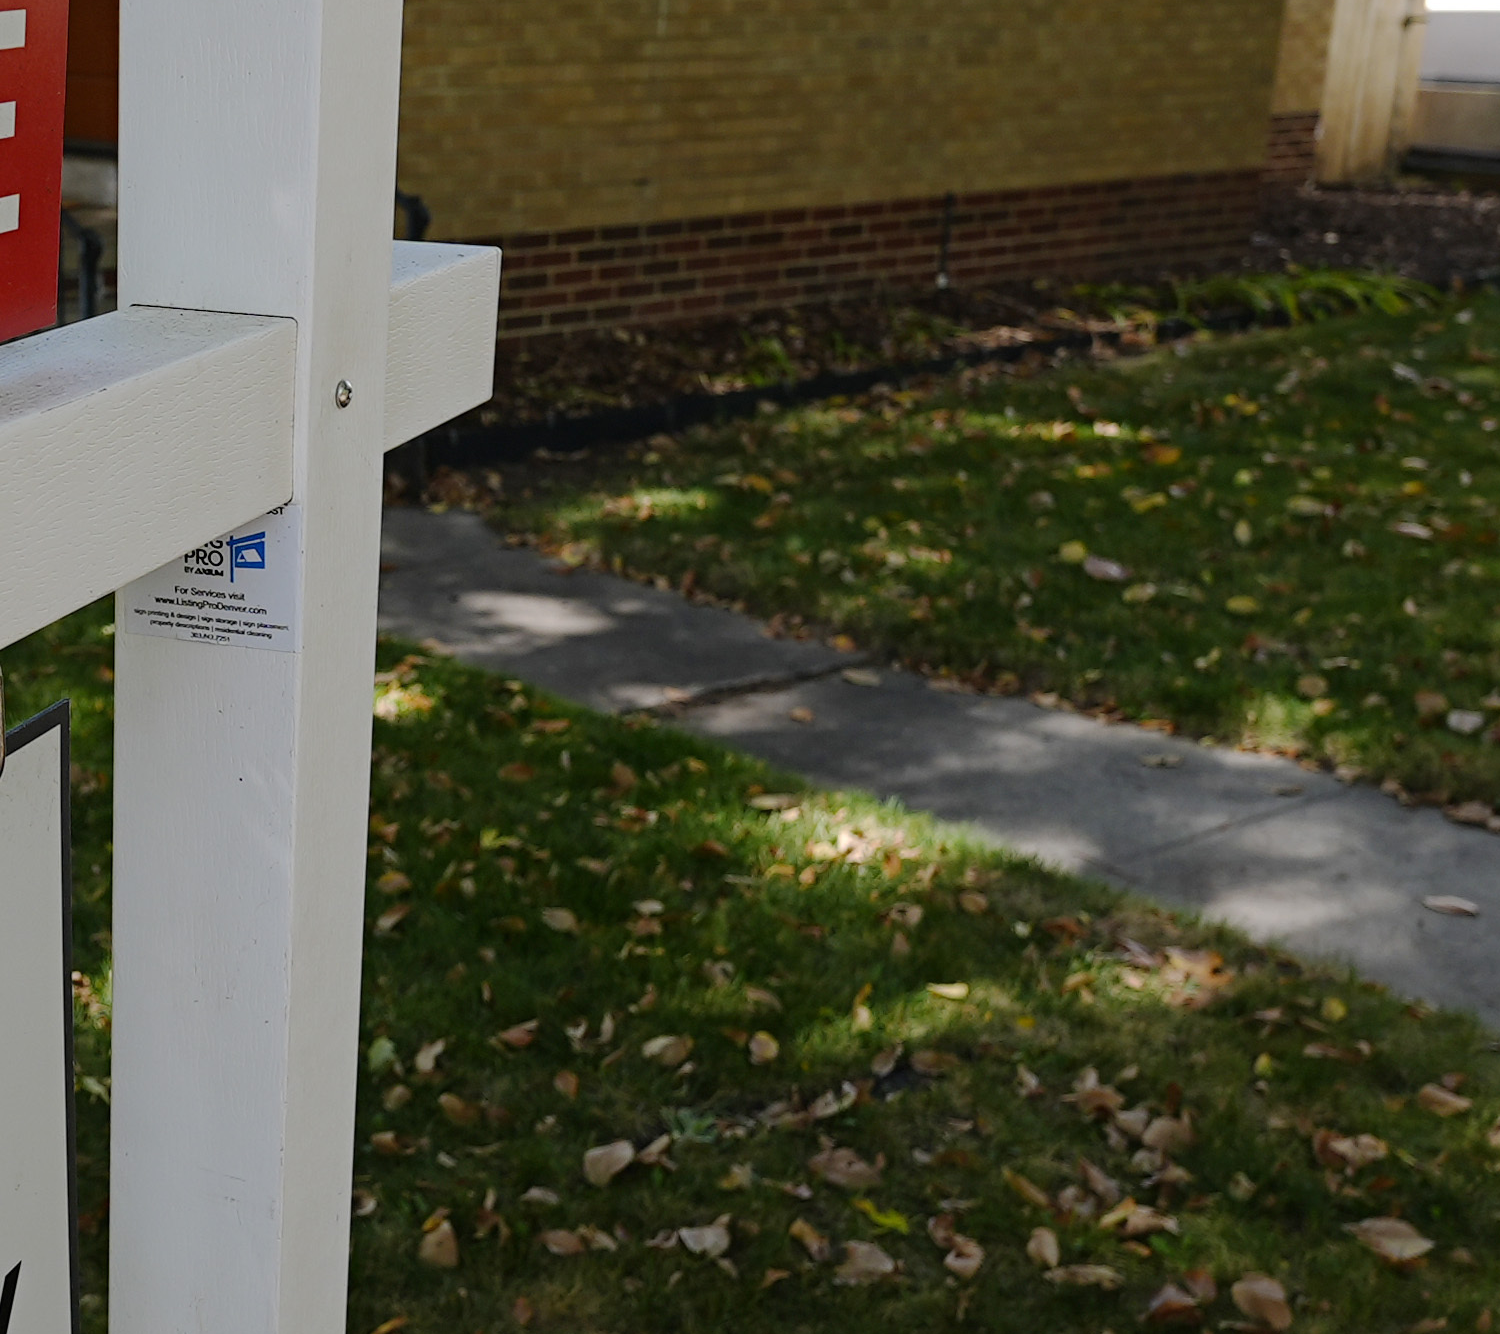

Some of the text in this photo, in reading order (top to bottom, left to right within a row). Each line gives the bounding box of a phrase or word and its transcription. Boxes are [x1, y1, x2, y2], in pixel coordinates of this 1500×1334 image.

[184, 548, 224, 567] PRO
[174, 585, 245, 602] For Services visit
[154, 596, 267, 616] www.ListingProDenver.com
